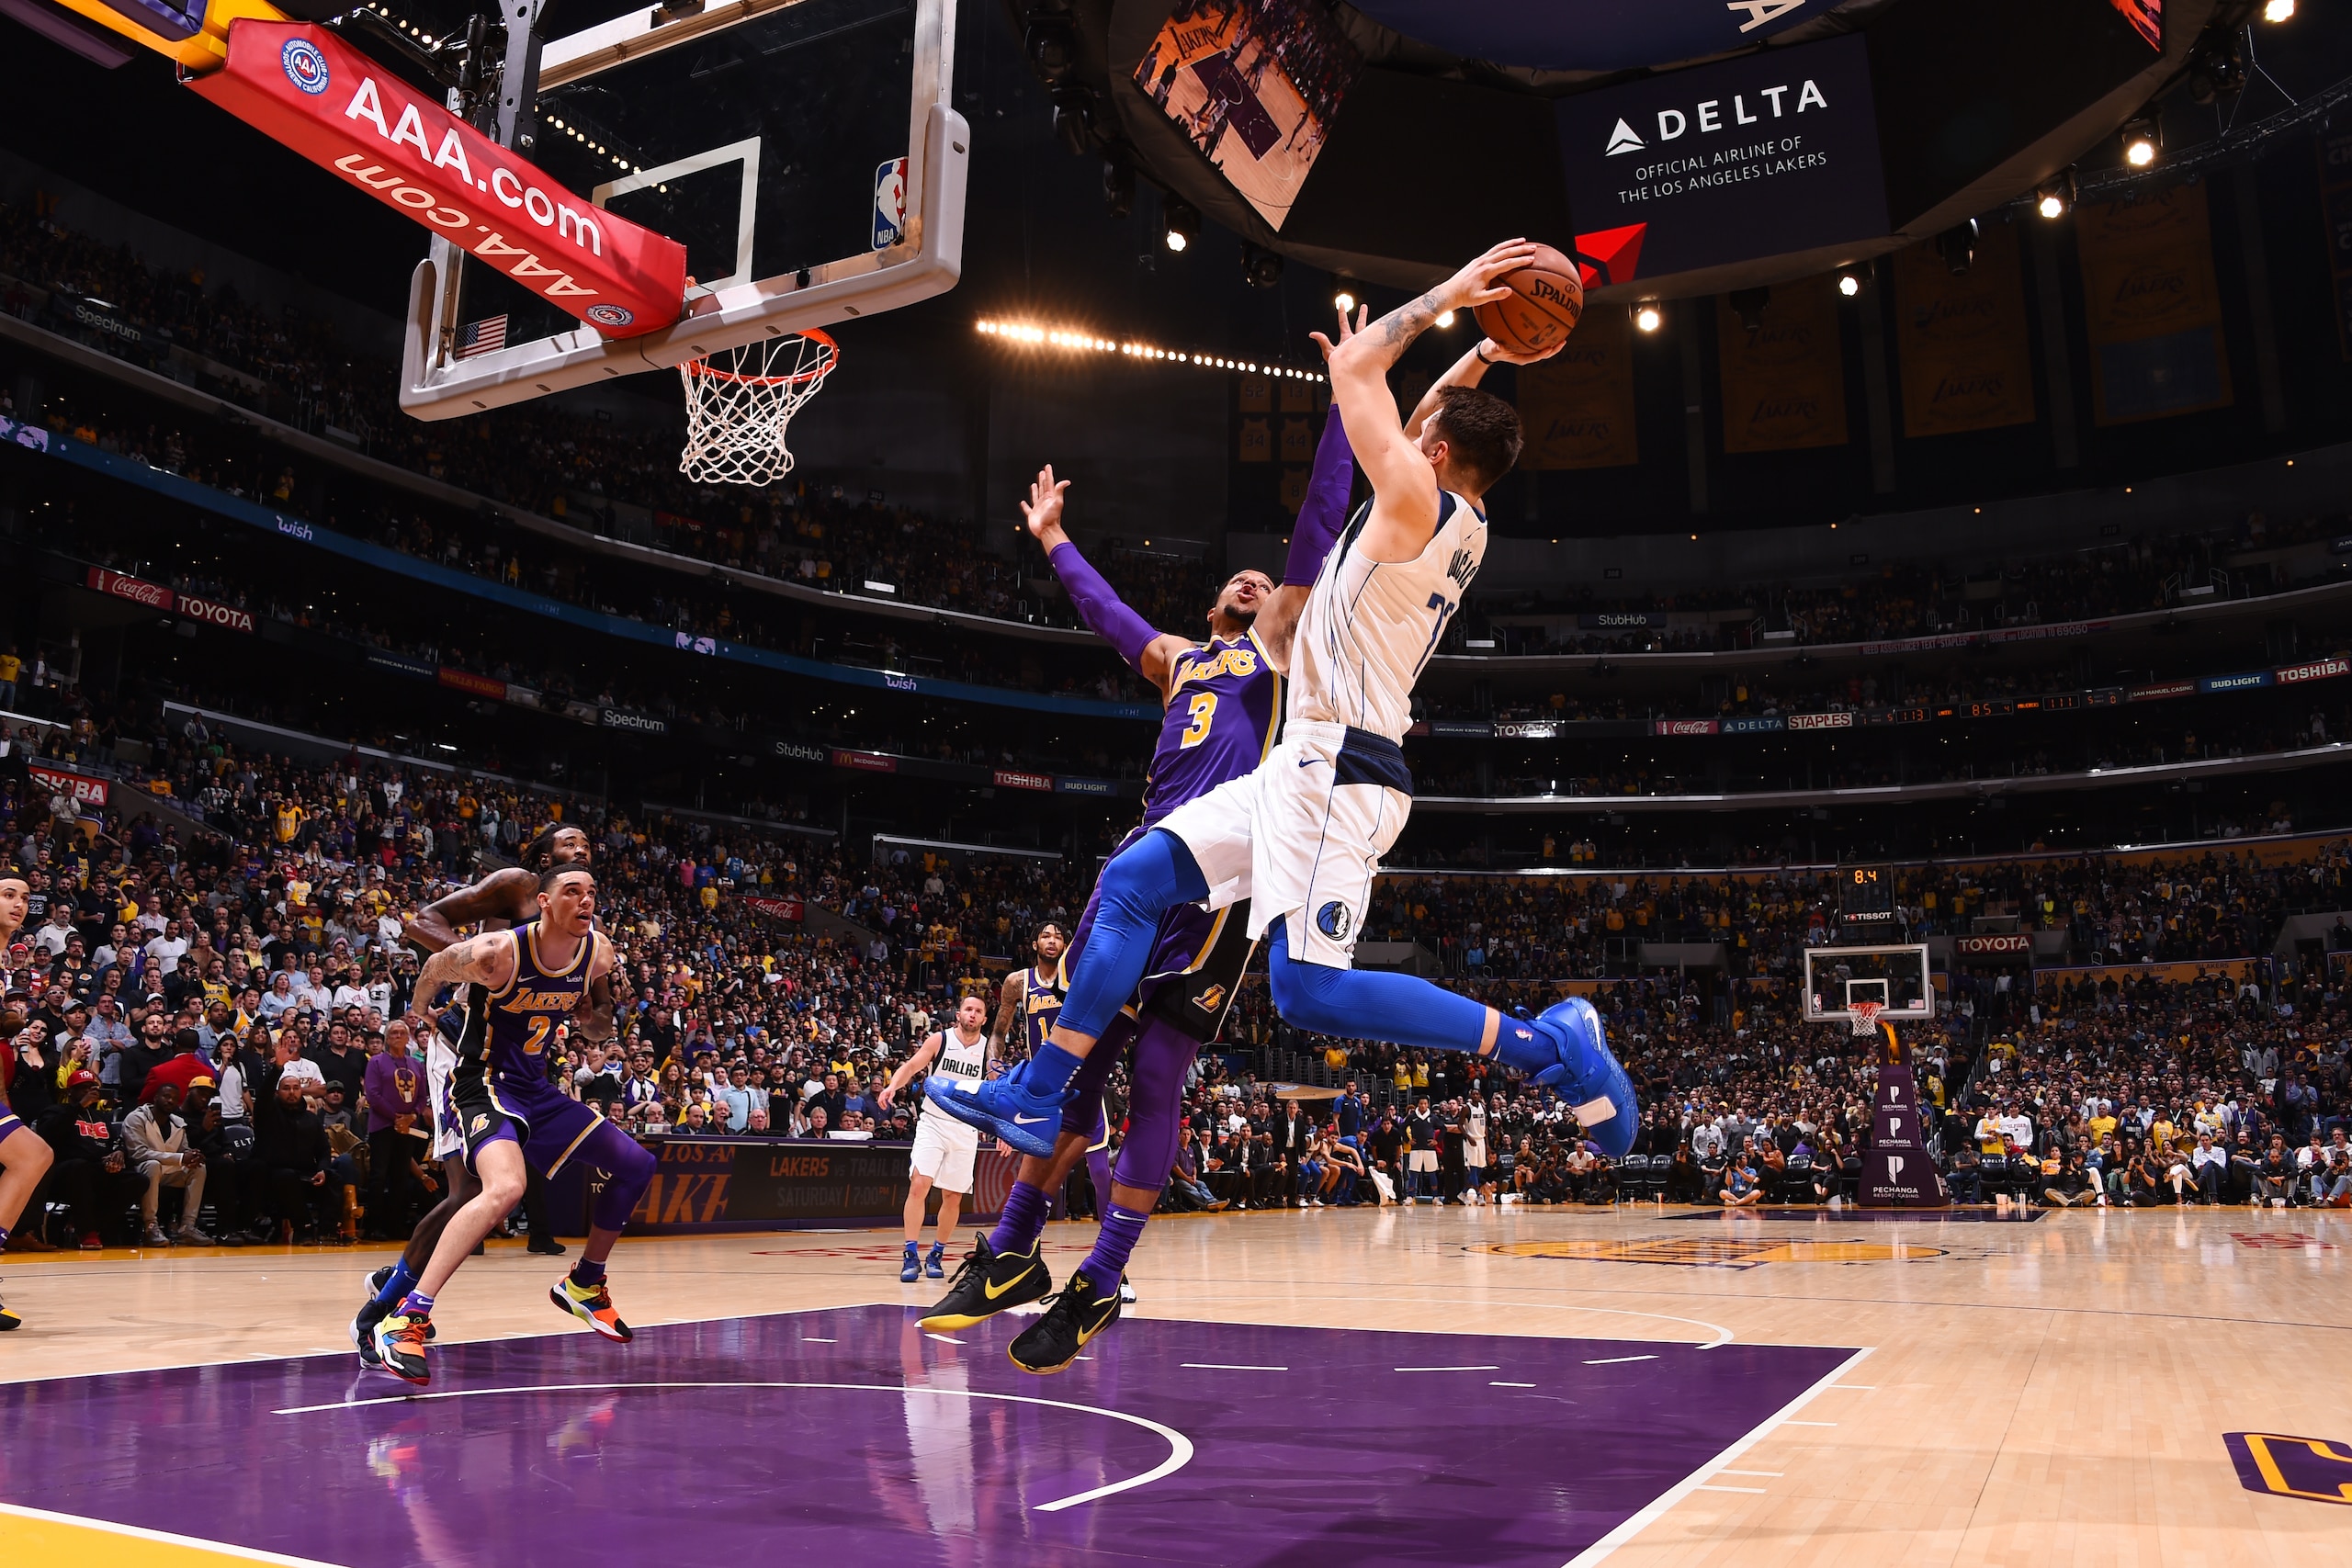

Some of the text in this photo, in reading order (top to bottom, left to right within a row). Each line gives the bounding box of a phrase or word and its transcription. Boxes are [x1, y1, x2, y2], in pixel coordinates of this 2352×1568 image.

[286, 39, 328, 73] AUTOMOBILE CLUB
[295, 55, 316, 75] AAA
[283, 52, 302, 87] SOUTHERN
[1657, 80, 1827, 141] DELTA
[345, 76, 601, 256] AAA.com
[1635, 135, 1802, 180] OFFICIAL AIRLINE OF
[1618, 152, 1826, 204] THE LOS ANGELES LAKERS
[334, 153, 600, 295] AAA.com
[876, 228, 895, 245] NBA
[1530, 278, 1581, 320] SPALDIN
[74, 304, 141, 342] Spectrum
[277, 514, 313, 541] wish
[112, 577, 164, 605] Coca-Cola
[178, 595, 253, 632] TOYOTA
[1599, 615, 1647, 626] StubHub
[2055, 624, 2087, 637] 69050
[368, 656, 433, 676] AMERICAN EXPRESS
[2278, 660, 2348, 682] TOSHIBA
[441, 671, 504, 695] WELLS FARGO
[885, 675, 917, 691] wish
[2145, 687, 2170, 696] MANUEL
[2171, 685, 2193, 694] CASINO
[2211, 676, 2261, 689] BUD LIGHT
[604, 710, 664, 732] Spectrum
[1180, 692, 1218, 750] 3
[1497, 724, 1556, 738] TOYOTA
[1672, 721, 1711, 734] Coca-Cola
[1736, 720, 1783, 731] DELTA
[1789, 714, 1850, 729] STAPLES
[775, 742, 824, 761] StubHub
[854, 757, 888, 767] McDonald's
[995, 772, 1051, 790] TOSHIBA
[1065, 782, 1107, 792] BUD LIGHT
[1854, 870, 1877, 885] 8.4
[1857, 911, 1892, 920] TISSOT
[1959, 937, 2030, 953] TOYOTA
[499, 987, 582, 1014] LAKERS
[523, 1016, 550, 1055] 2
[1038, 1017, 1049, 1045] 1
[942, 1058, 980, 1077] DALLAS
[661, 1144, 706, 1162] LOS
[770, 1156, 830, 1177] LAKERS
[850, 1158, 888, 1177] TRAIL
[776, 1185, 842, 1207] SATURDAY
